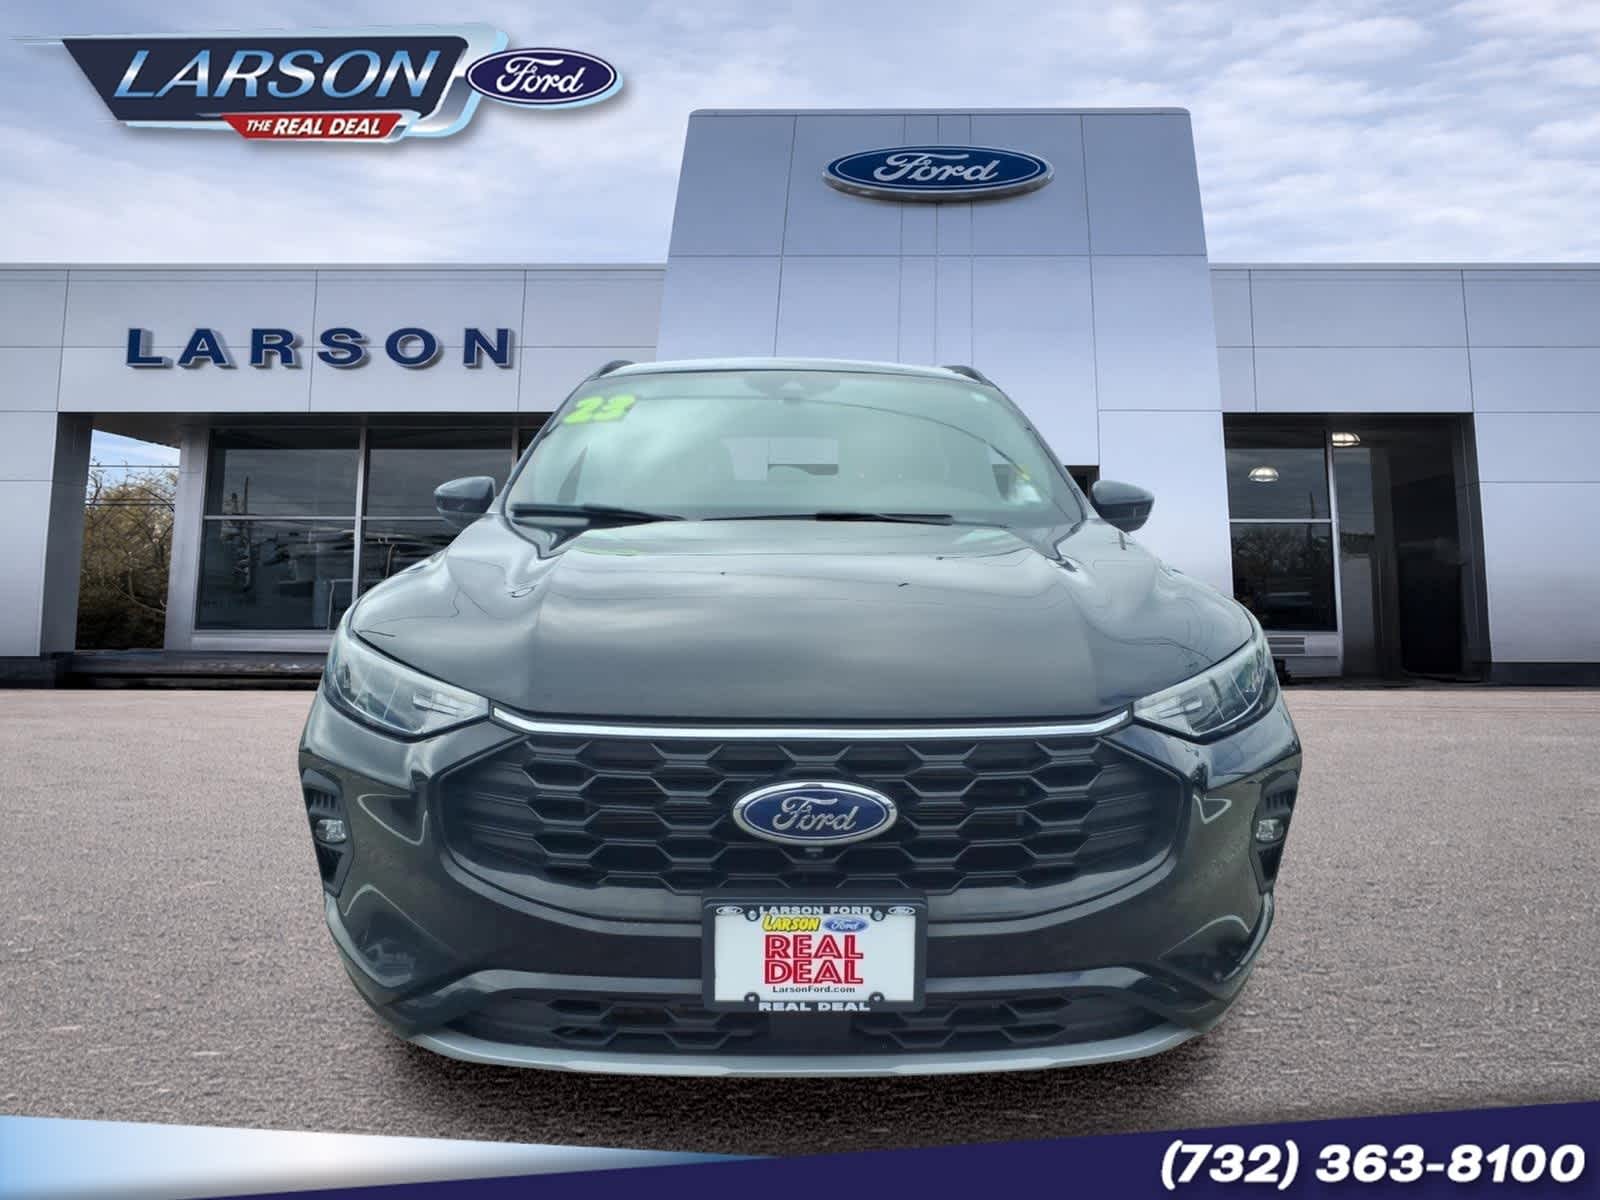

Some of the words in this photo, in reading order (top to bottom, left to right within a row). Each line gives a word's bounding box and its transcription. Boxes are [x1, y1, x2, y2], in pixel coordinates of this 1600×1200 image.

[873, 152, 1000, 182] Ford
[126, 327, 515, 368] LARSON
[562, 394, 637, 424] 23
[772, 796, 860, 831] Ford
[759, 905, 824, 915] LARSON
[830, 905, 873, 915] FORD
[762, 914, 821, 932] LARSON
[830, 919, 861, 931] Ford
[764, 934, 864, 959] REAL
[764, 959, 864, 984] DEAL
[772, 984, 856, 993] LarsonFord.com
[758, 1002, 811, 1012] REAL
[818, 1002, 871, 1012] DEAL
